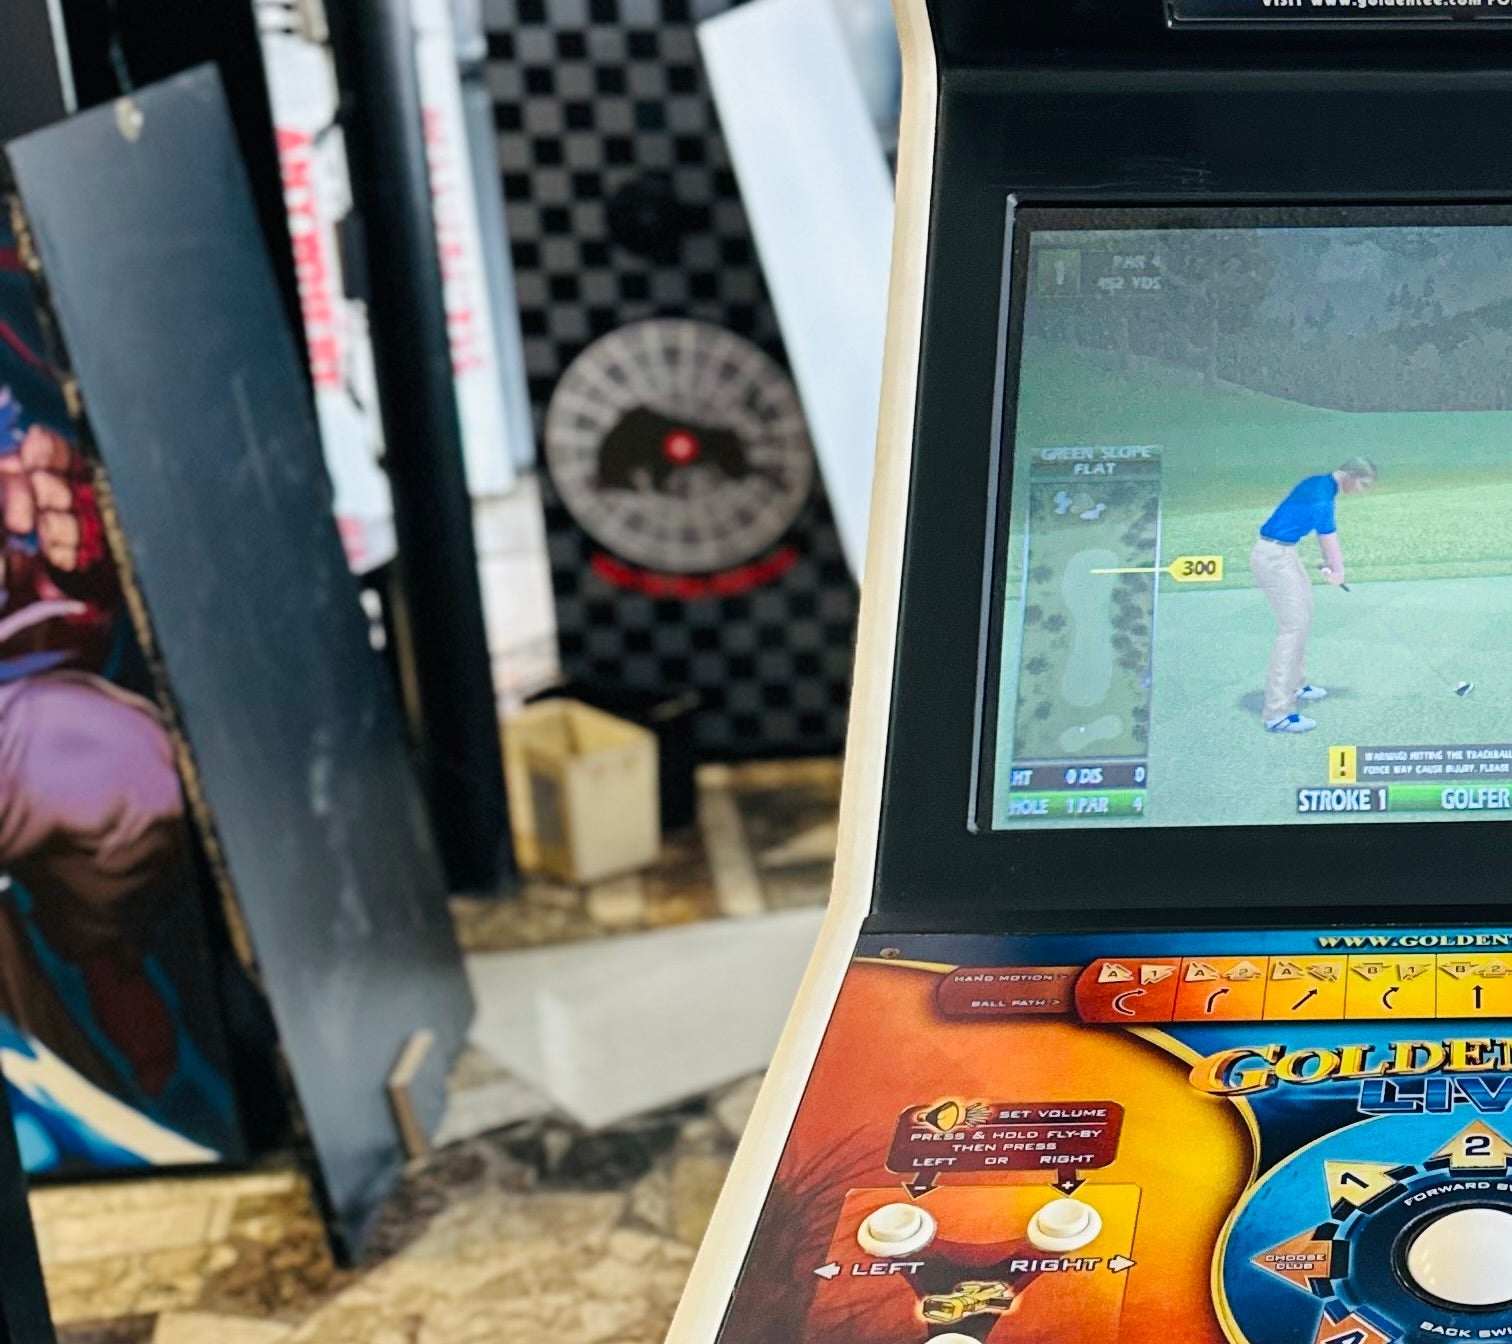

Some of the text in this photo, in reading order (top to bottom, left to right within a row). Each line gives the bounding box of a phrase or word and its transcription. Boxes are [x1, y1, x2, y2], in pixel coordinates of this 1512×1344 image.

[1041, 445, 1152, 460] GREEN SLOPE
[1074, 462, 1117, 475] FLAT
[1182, 560, 1217, 576] 300
[1009, 799, 1048, 815] HOLE
[1076, 796, 1110, 813] PAR
[1299, 788, 1387, 812] STROKE 1
[1442, 787, 1511, 810] GOLFER
[999, 1108, 1107, 1120] SET VOLUME
[911, 1129, 1102, 1142] PRESS & HOLD FLY-BY
[952, 1142, 1057, 1153] THEN PRESS
[1464, 1135, 1492, 1157] 2
[913, 1154, 1095, 1167] LEFT OR RIGHT
[1340, 1170, 1371, 1190] 1
[1404, 1181, 1491, 1207] FORWARD
[851, 1258, 1102, 1276] LEFT RIGHT
[1419, 1320, 1472, 1338] BACK
